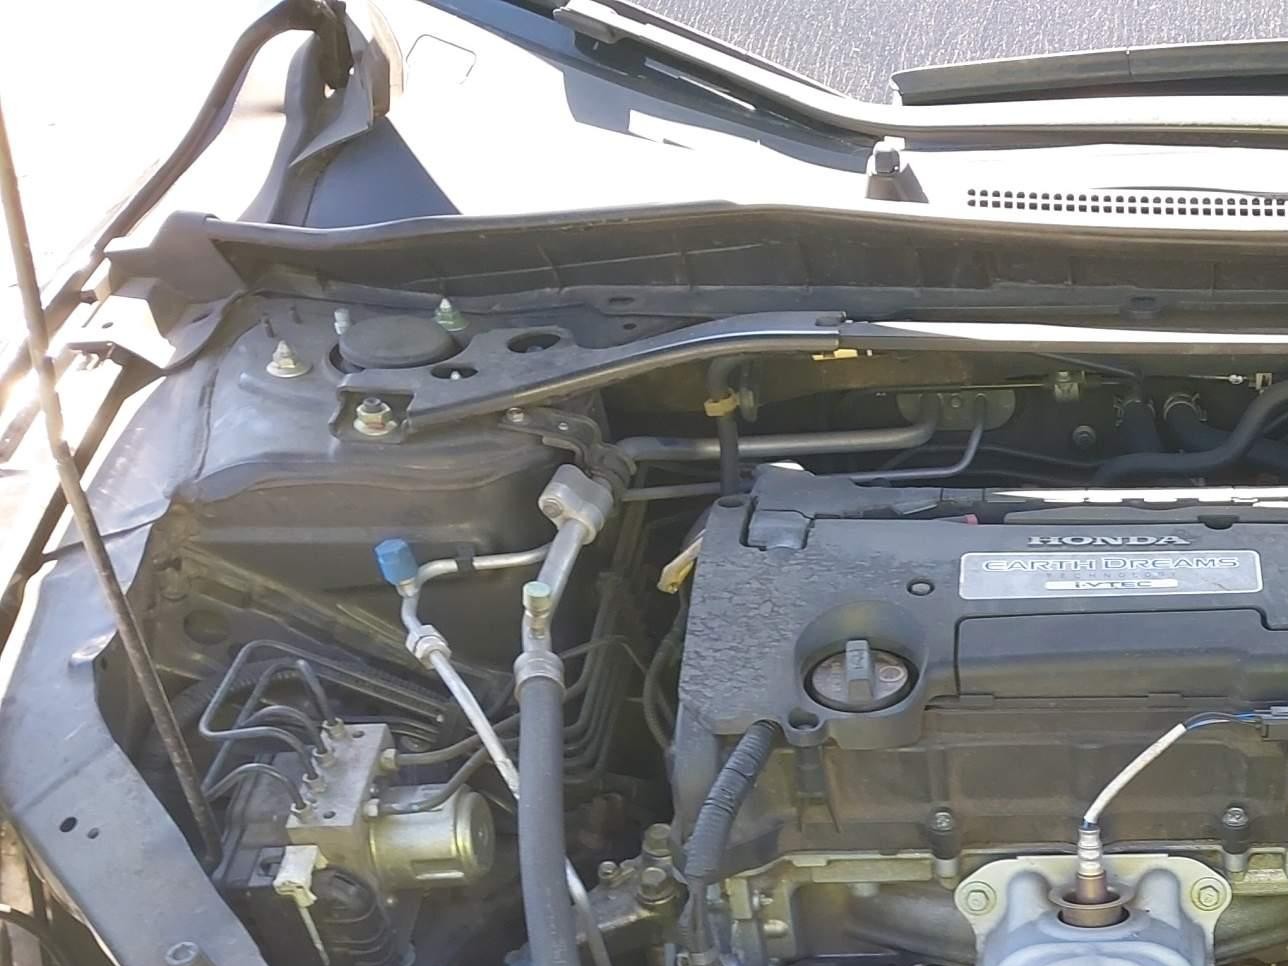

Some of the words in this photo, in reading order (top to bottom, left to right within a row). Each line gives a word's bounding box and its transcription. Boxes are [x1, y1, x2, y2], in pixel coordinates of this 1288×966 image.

[1028, 535, 1192, 547] HONDA
[984, 560, 1096, 571] EARTH
[1102, 556, 1240, 571] DREAMS
